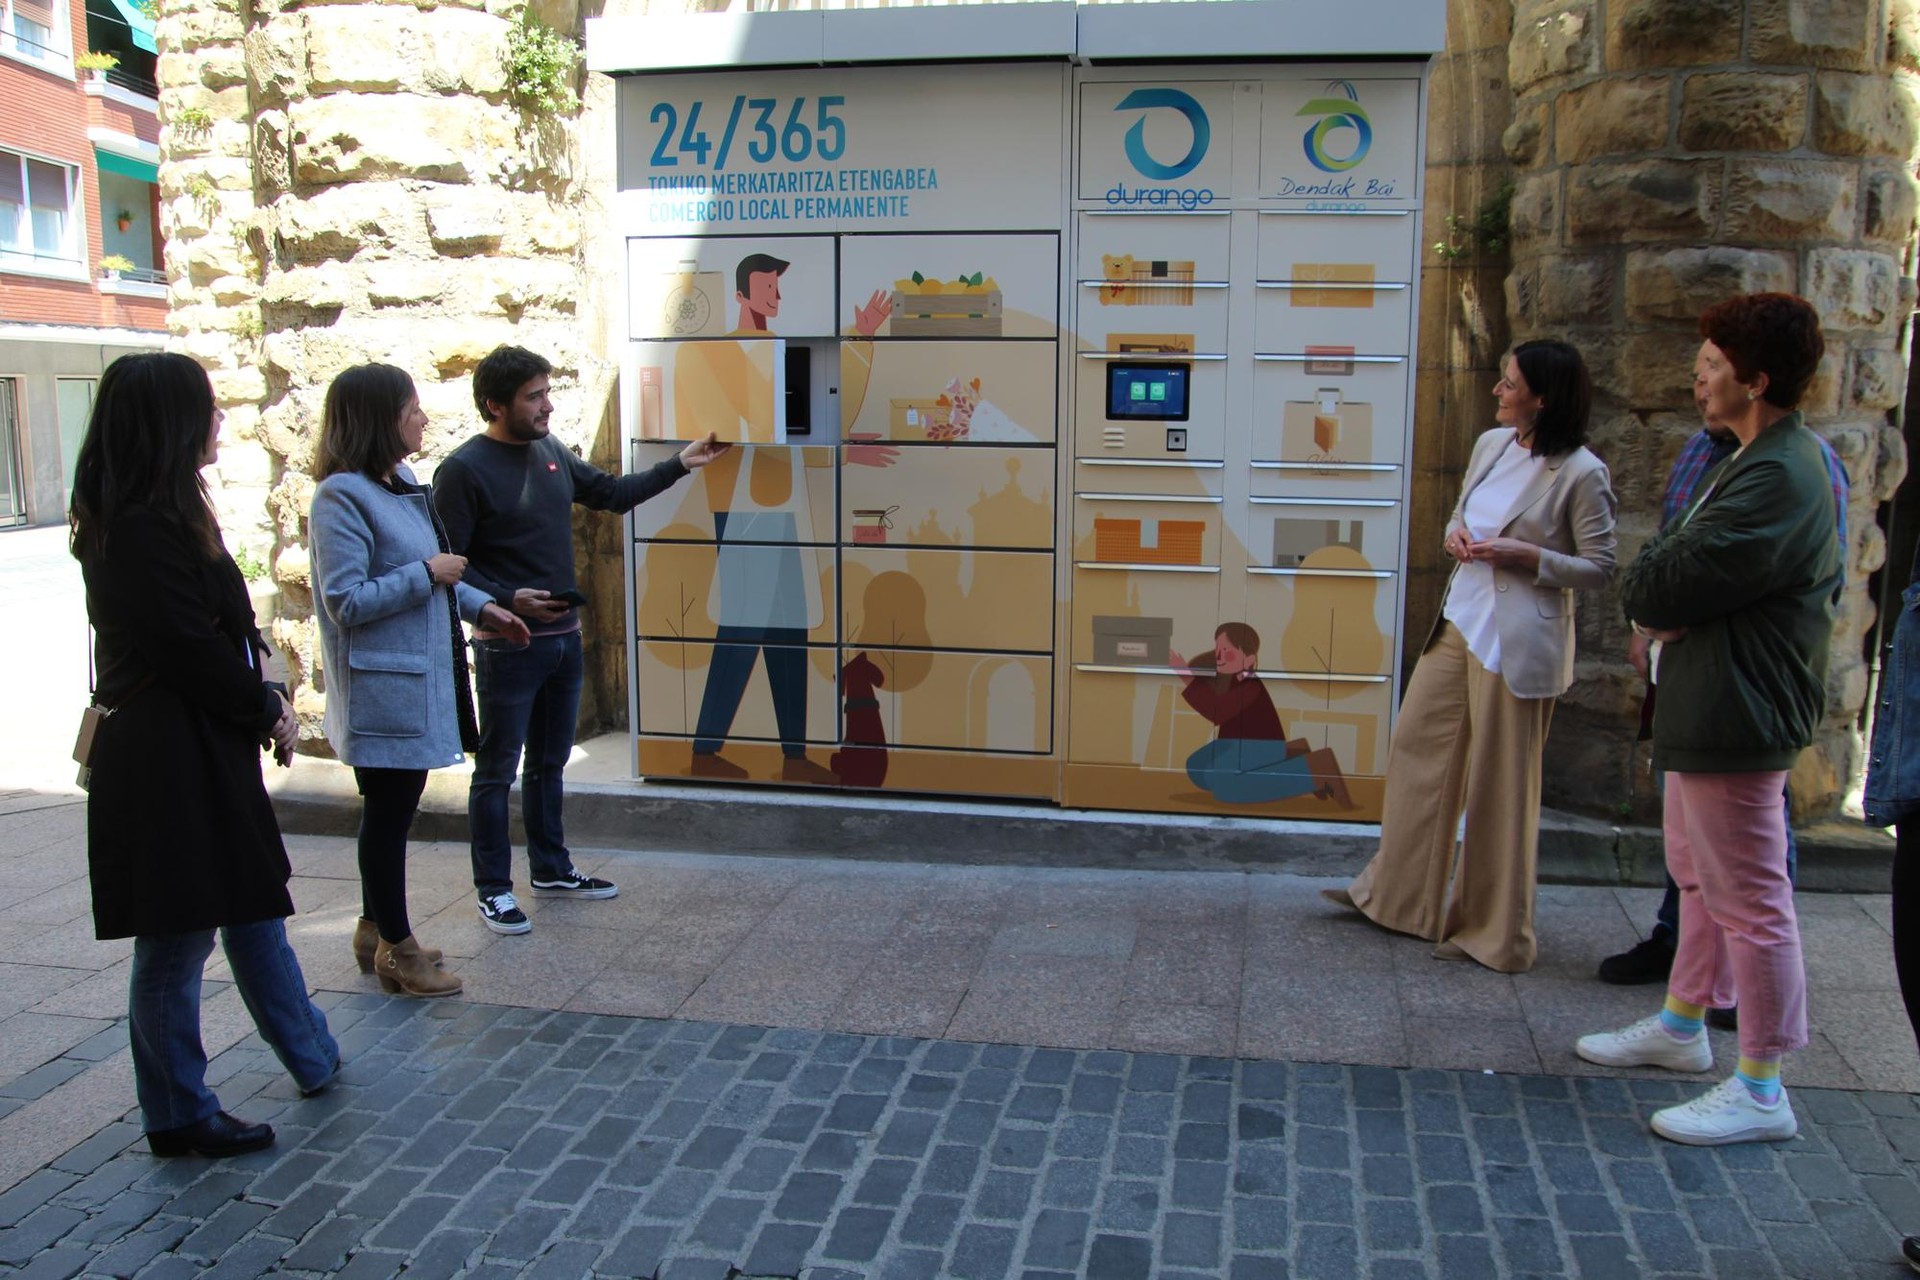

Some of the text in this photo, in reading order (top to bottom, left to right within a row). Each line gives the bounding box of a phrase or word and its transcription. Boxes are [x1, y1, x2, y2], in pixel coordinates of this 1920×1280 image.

[649, 96, 847, 170] 24/365
[648, 168, 938, 196] TOKIKO MERKATARITZA ETENGABEA
[1277, 176, 1396, 198] Dendak Bai
[649, 195, 910, 222] COMERCIO LOCAL PERMANENTE
[1106, 182, 1214, 211] durango
